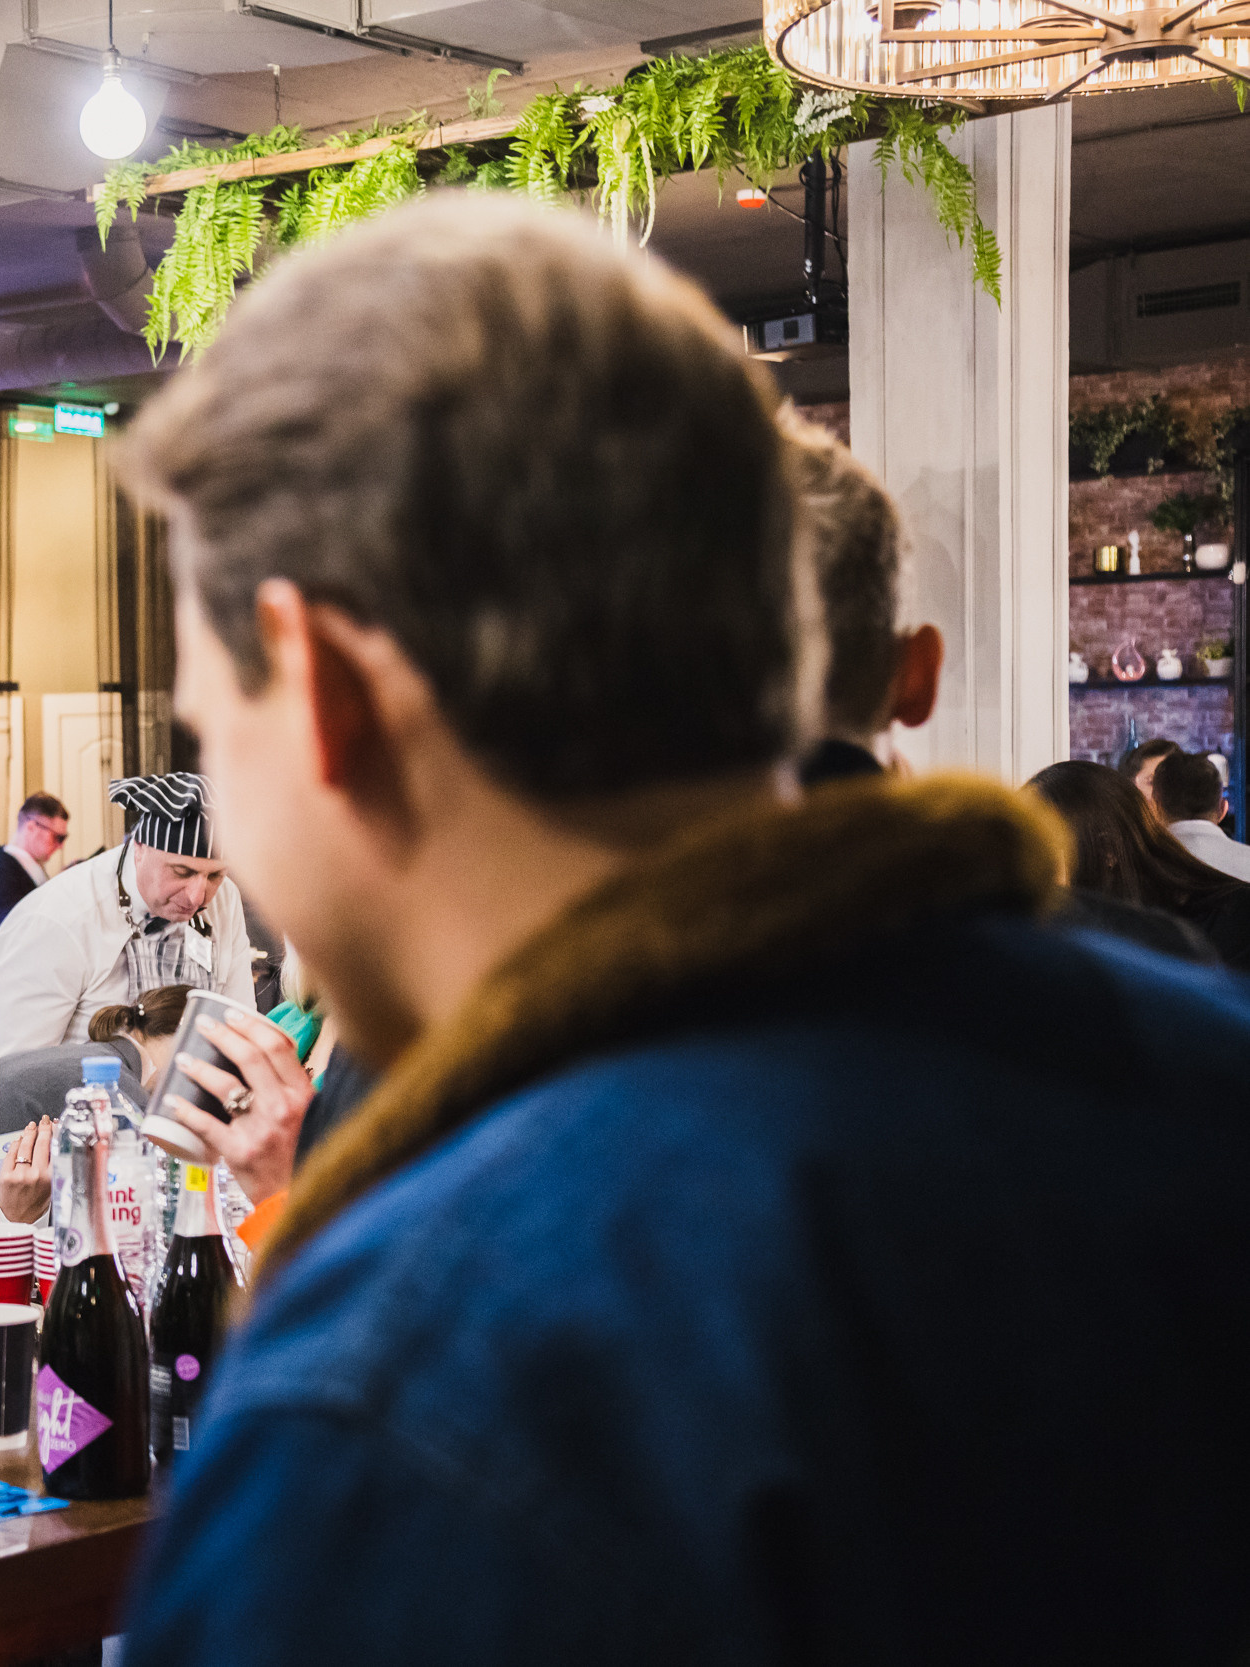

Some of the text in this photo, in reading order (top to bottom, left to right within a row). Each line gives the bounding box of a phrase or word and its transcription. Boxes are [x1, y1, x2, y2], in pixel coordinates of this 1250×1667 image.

[108, 1187, 136, 1204] int
[111, 1207, 141, 1226] ing
[38, 1387, 85, 1466] ight
